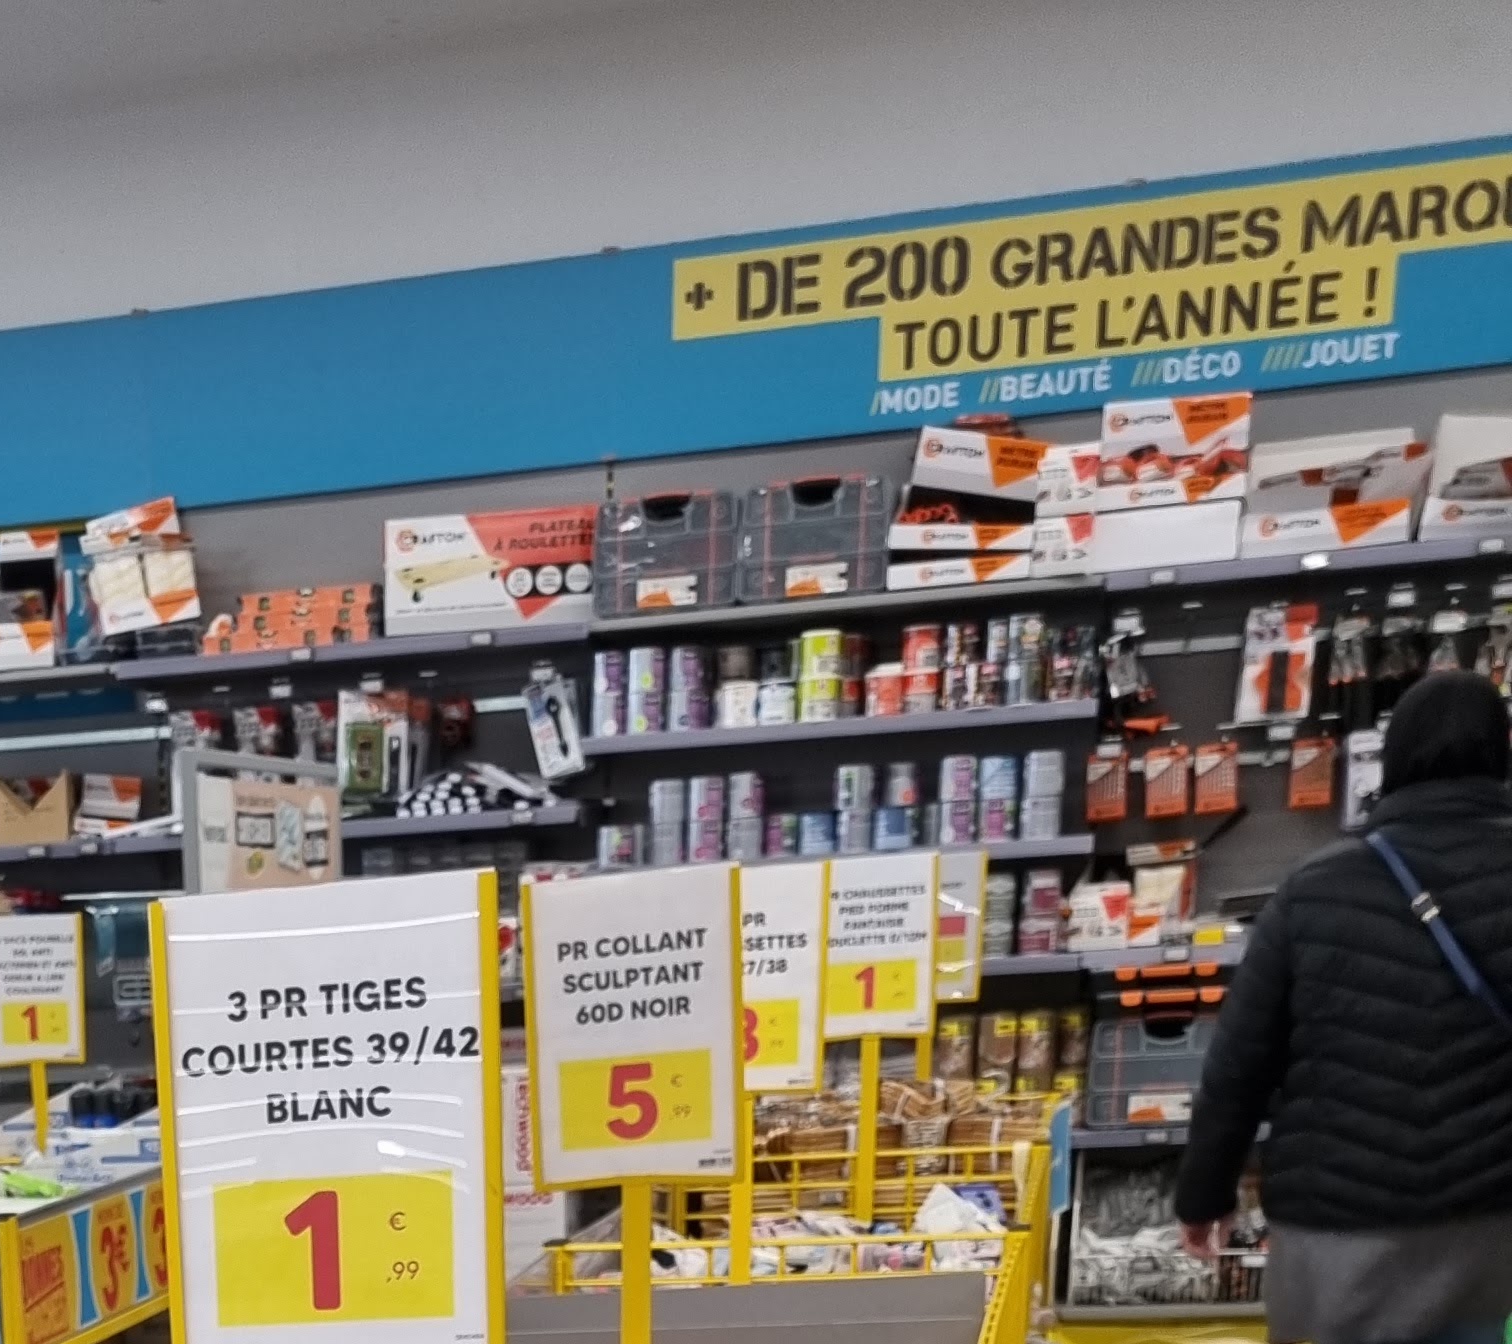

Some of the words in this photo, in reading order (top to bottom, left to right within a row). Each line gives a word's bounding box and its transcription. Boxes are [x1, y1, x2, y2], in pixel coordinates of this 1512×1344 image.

[737, 254, 822, 321] DE
[844, 236, 970, 308] 200
[989, 206, 1282, 287] GRANDES
[895, 303, 1075, 371] TOUTE
[1096, 259, 1343, 351] L'ANNÉE
[1363, 266, 1381, 317] !
[557, 941, 589, 962] PR
[594, 927, 709, 959] COLLANT
[745, 933, 808, 951] SETTES
[226, 990, 248, 1023] 3
[259, 985, 308, 1020] PR
[319, 976, 428, 1016] TIGES
[563, 961, 705, 994] SCULPTANT
[855, 965, 876, 1010] 1
[21, 1004, 39, 1041] 1
[575, 1002, 623, 1025] 60D
[630, 995, 692, 1020] NOIR
[182, 1035, 354, 1079] COURTES
[365, 1025, 480, 1066] 39/42
[266, 1085, 394, 1126] BLANC
[606, 1061, 659, 1141] 5
[284, 1190, 343, 1311] 1
[388, 1210, 407, 1232] €
